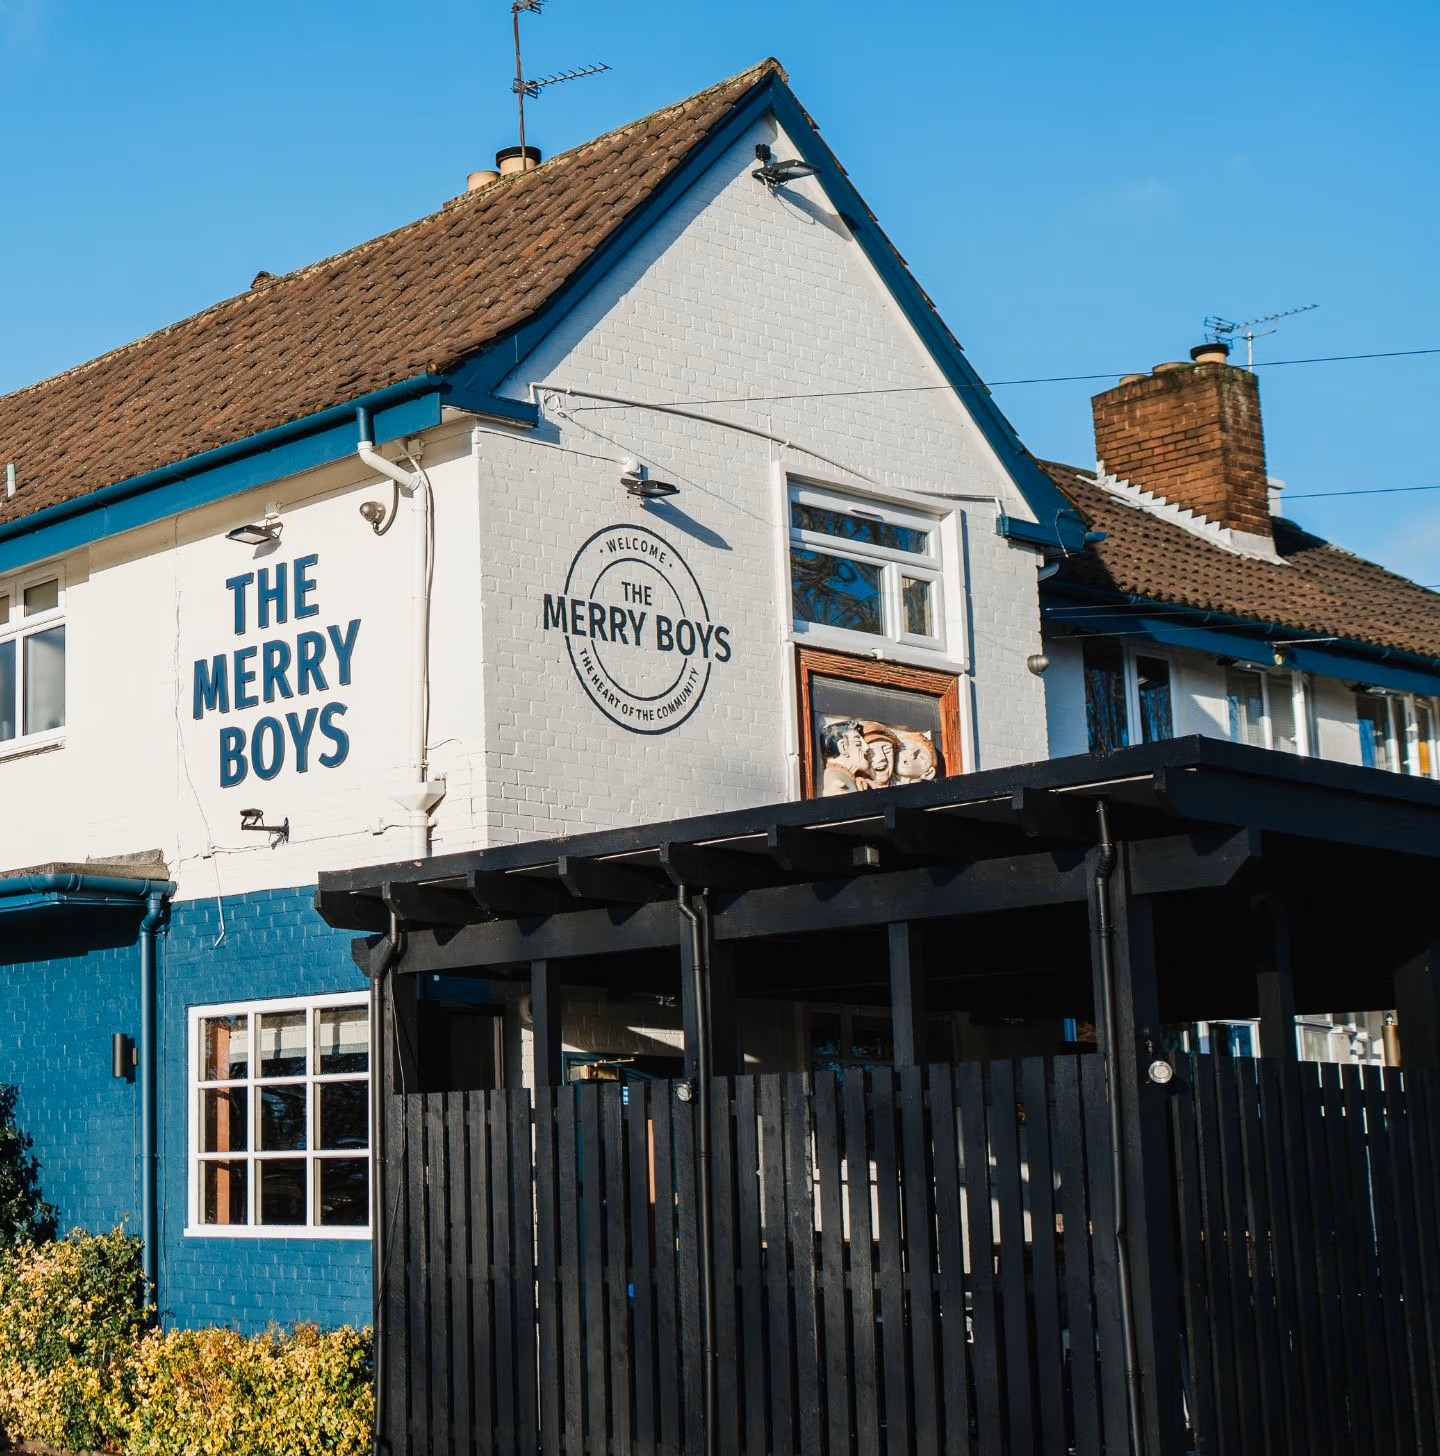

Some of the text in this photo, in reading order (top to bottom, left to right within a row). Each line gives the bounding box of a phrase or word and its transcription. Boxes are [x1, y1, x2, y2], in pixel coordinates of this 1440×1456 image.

[606, 537, 666, 564] WELCOME
[226, 553, 319, 636] THE
[543, 593, 732, 663] MERRY BOYS
[621, 581, 653, 606] THE
[193, 618, 362, 720] MERRY
[579, 647, 699, 721] THE HEART OF THE COMMUNITY
[219, 701, 350, 789] BOYS
